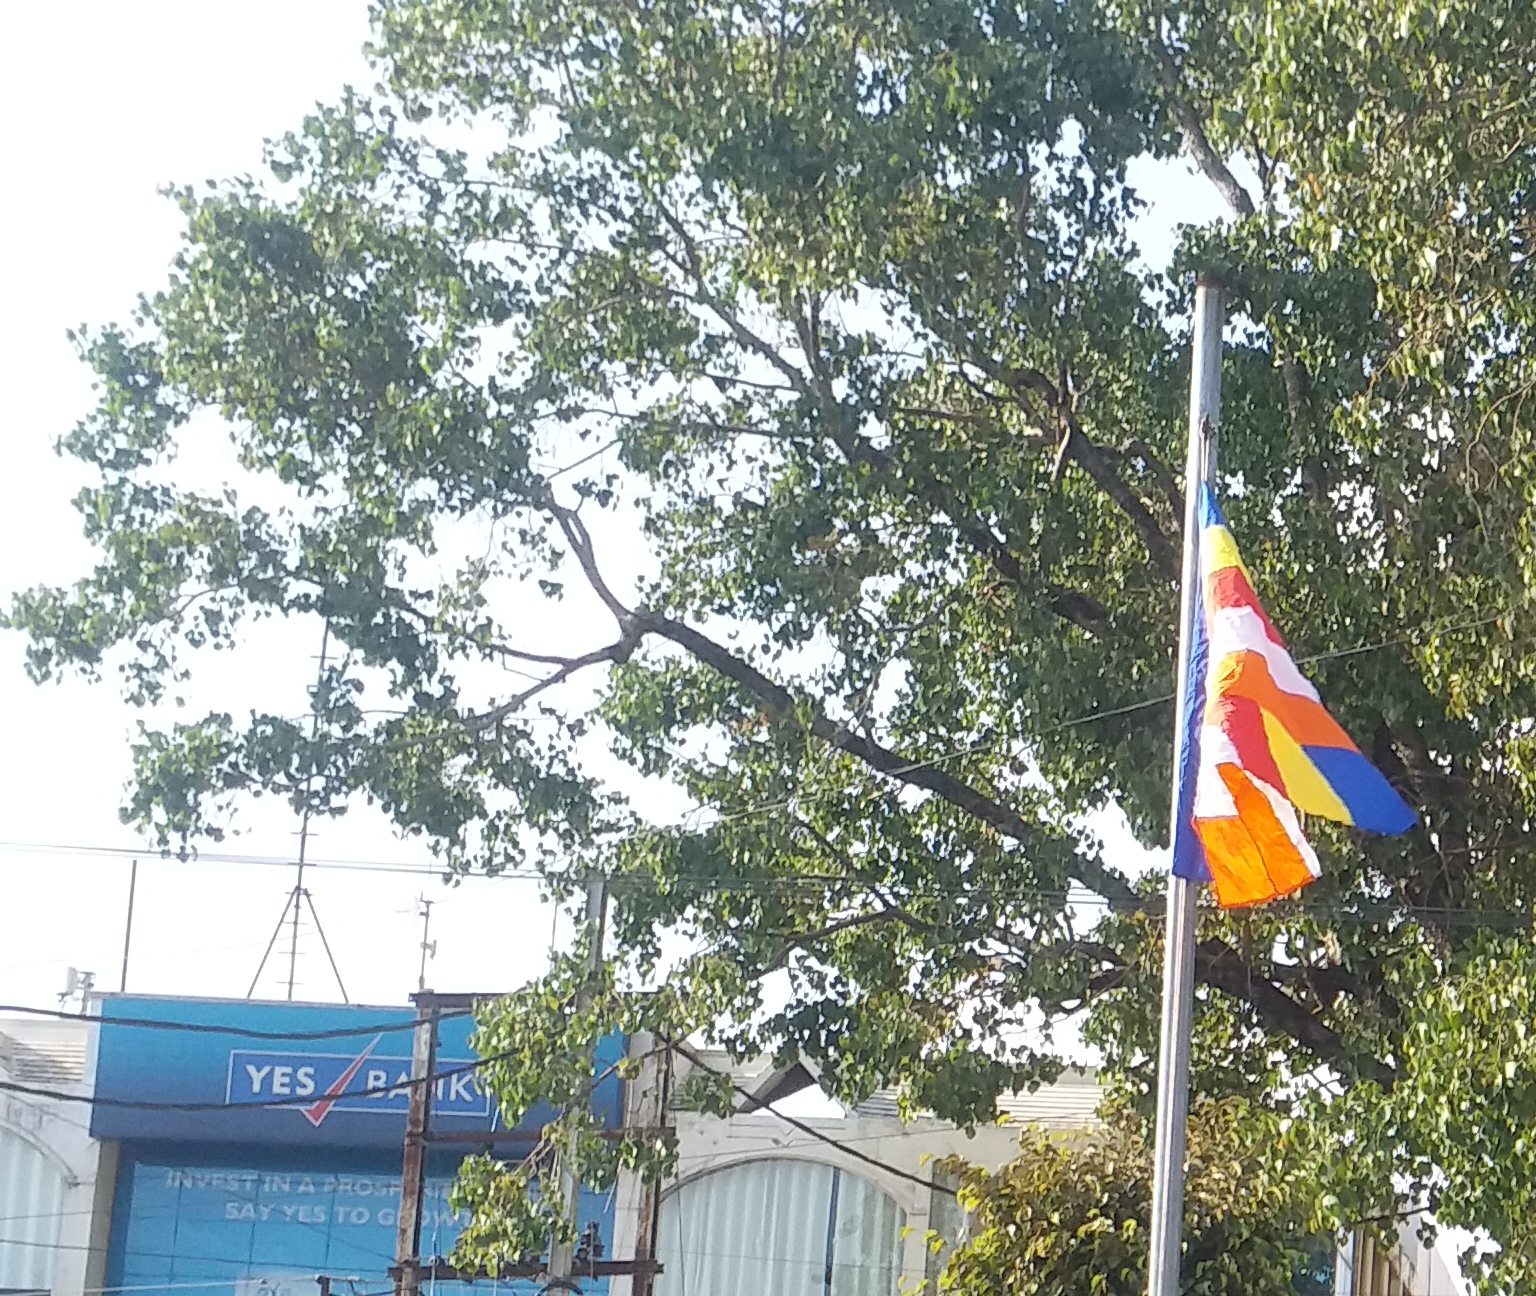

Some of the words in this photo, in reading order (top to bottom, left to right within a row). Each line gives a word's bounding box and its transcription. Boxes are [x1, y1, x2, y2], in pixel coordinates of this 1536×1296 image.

[245, 1064, 315, 1096] YES
[164, 1169, 259, 1191] INVEST
[264, 1176, 291, 1193] IN
[298, 1177, 315, 1194] A
[225, 1202, 274, 1221] SAY
[283, 1205, 326, 1223] YES
[334, 1207, 371, 1225] TO
